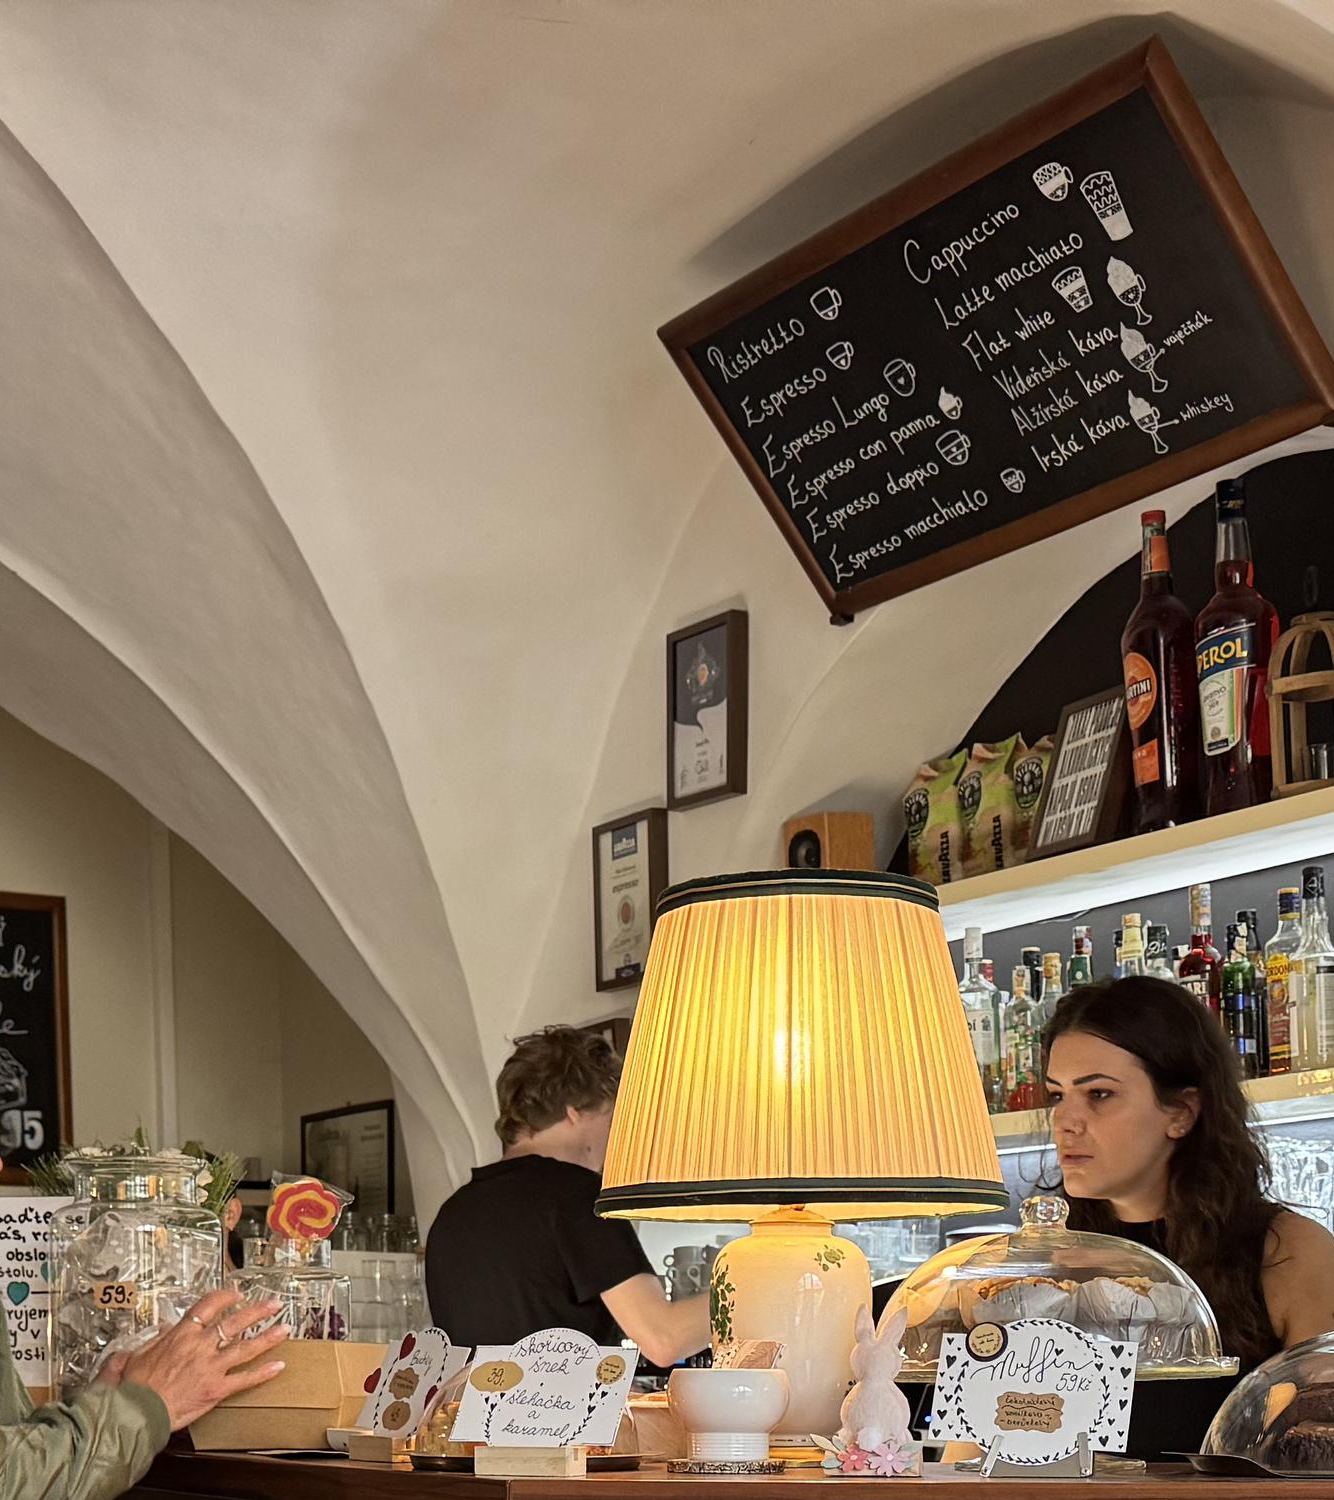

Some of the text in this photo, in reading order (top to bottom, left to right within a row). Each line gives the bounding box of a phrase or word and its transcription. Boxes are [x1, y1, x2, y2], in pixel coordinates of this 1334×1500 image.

[904, 203, 1020, 284] Cappuccino
[934, 232, 1083, 330] Latte macchiato
[707, 318, 805, 384] Ristretto
[962, 307, 1056, 372] Flat white
[1068, 325, 1118, 357] káva
[740, 366, 827, 428] Espresso
[1075, 366, 1124, 397] káva
[1179, 393, 1234, 423] whiskey
[762, 392, 890, 479] Espresso Lungo
[786, 413, 940, 509] Espresso con panna
[1031, 413, 1130, 472] Irská káva
[805, 461, 939, 544] Espresso doppio
[828, 489, 989, 584] Espresso macchiato
[1197, 637, 1249, 675] PEROL
[1126, 677, 1152, 701] RTINI
[6, 1247, 48, 1261] obslo
[970, 1336, 1094, 1383] Muffin
[501, 1423, 568, 1439] karamel
